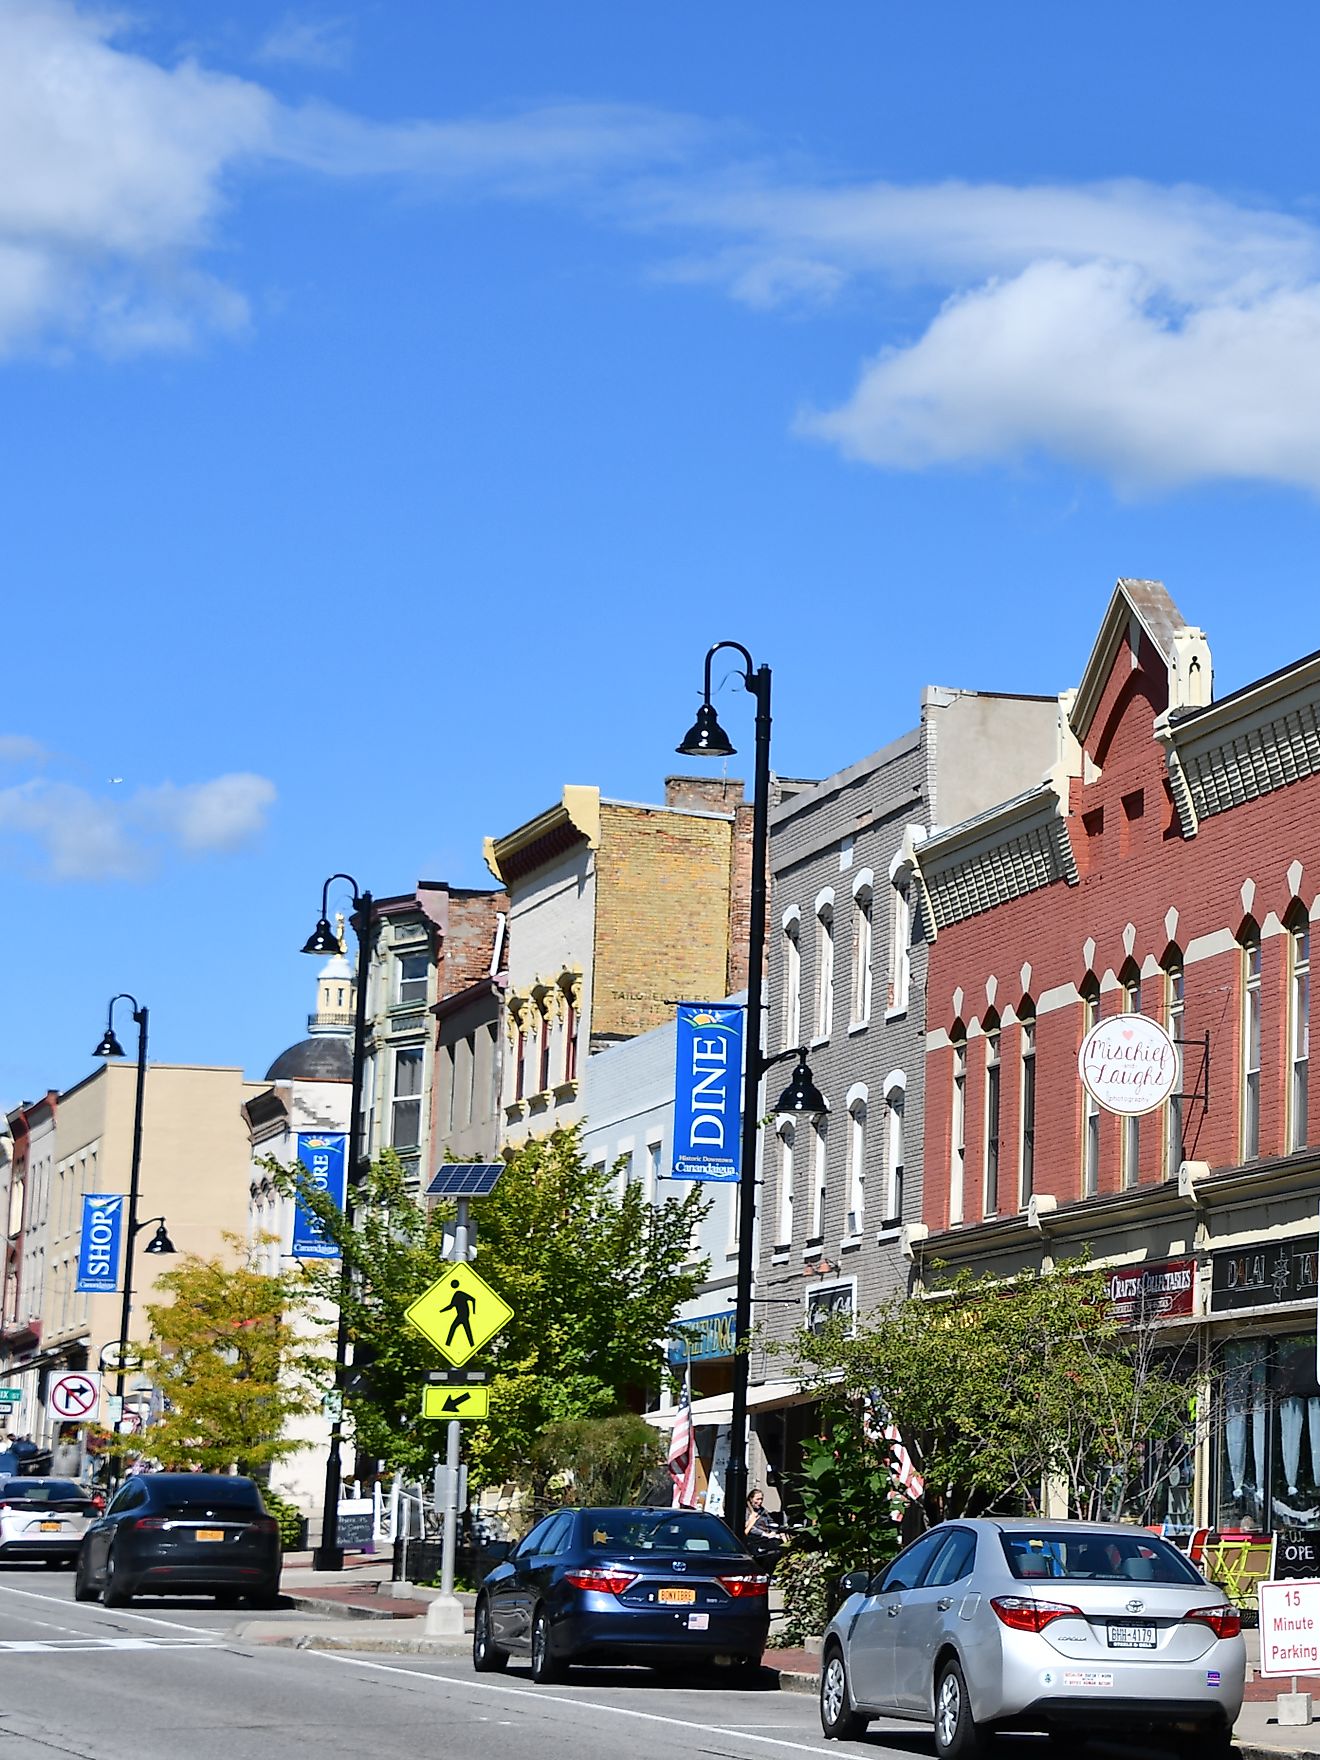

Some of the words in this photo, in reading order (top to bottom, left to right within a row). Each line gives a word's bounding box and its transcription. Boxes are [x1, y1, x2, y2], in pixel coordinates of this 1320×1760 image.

[1090, 1039, 1170, 1070] Mischief
[1087, 1063, 1170, 1095] Laughs
[689, 1035, 728, 1149] DINE
[674, 1161, 738, 1177] Canandaigua
[86, 1210, 113, 1276] SHOP
[1284, 1590, 1302, 1607] 15
[1273, 1617, 1314, 1632] Minute
[1272, 1644, 1318, 1661] Parking
